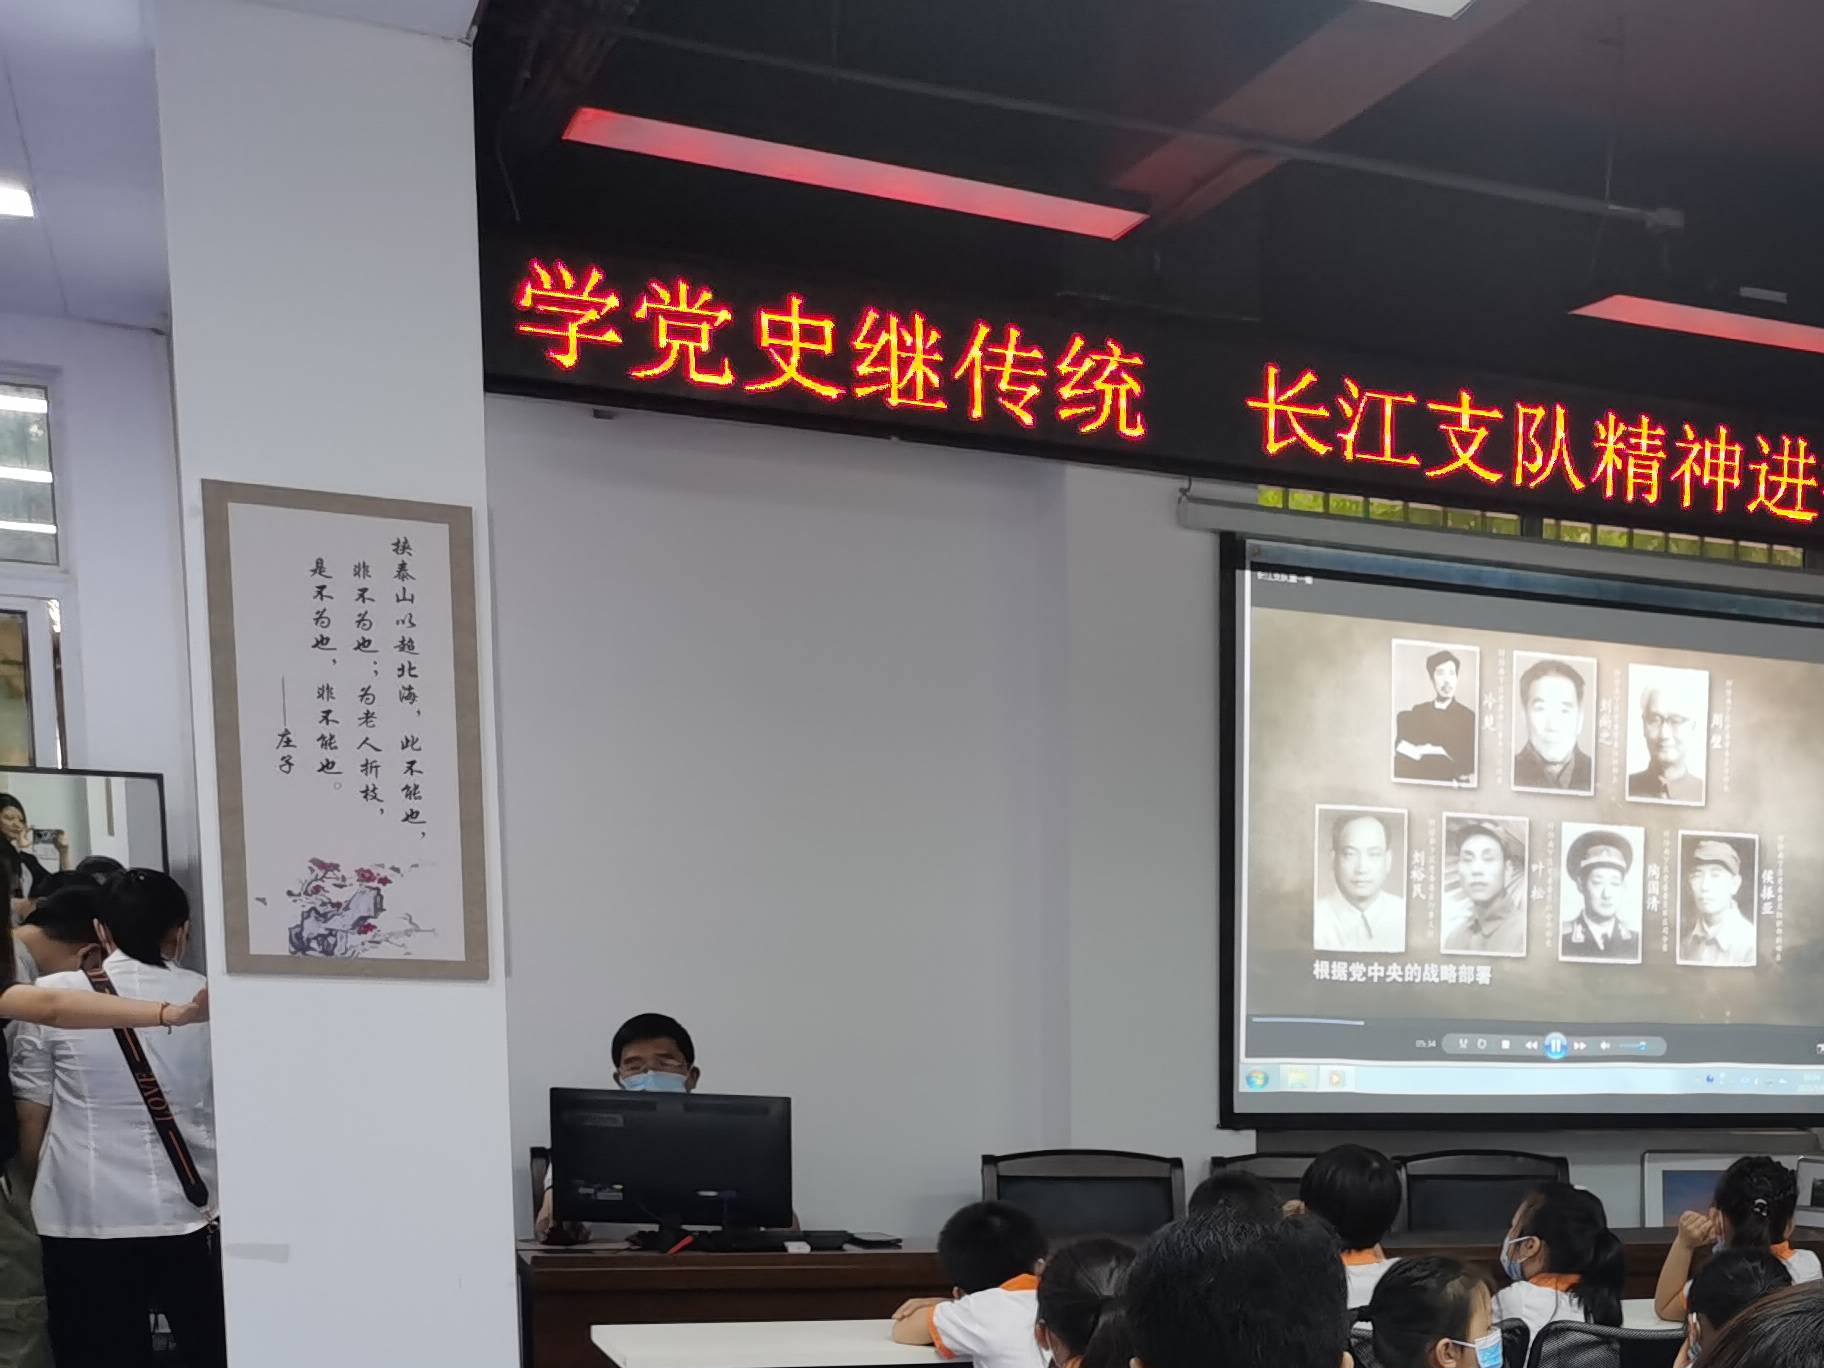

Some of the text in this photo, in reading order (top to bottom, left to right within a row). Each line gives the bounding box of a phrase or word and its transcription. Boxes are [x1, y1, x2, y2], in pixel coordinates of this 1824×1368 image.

[515, 258, 1147, 439] 学党史继传统
[310, 557, 343, 790] 是不为也，非不能也。
[353, 560, 384, 816] 非不为也；为老人折枝，
[391, 536, 427, 839] 挟泰山以超北海，此不能也，
[1313, 960, 1493, 985] 根据党中央的战略部署
